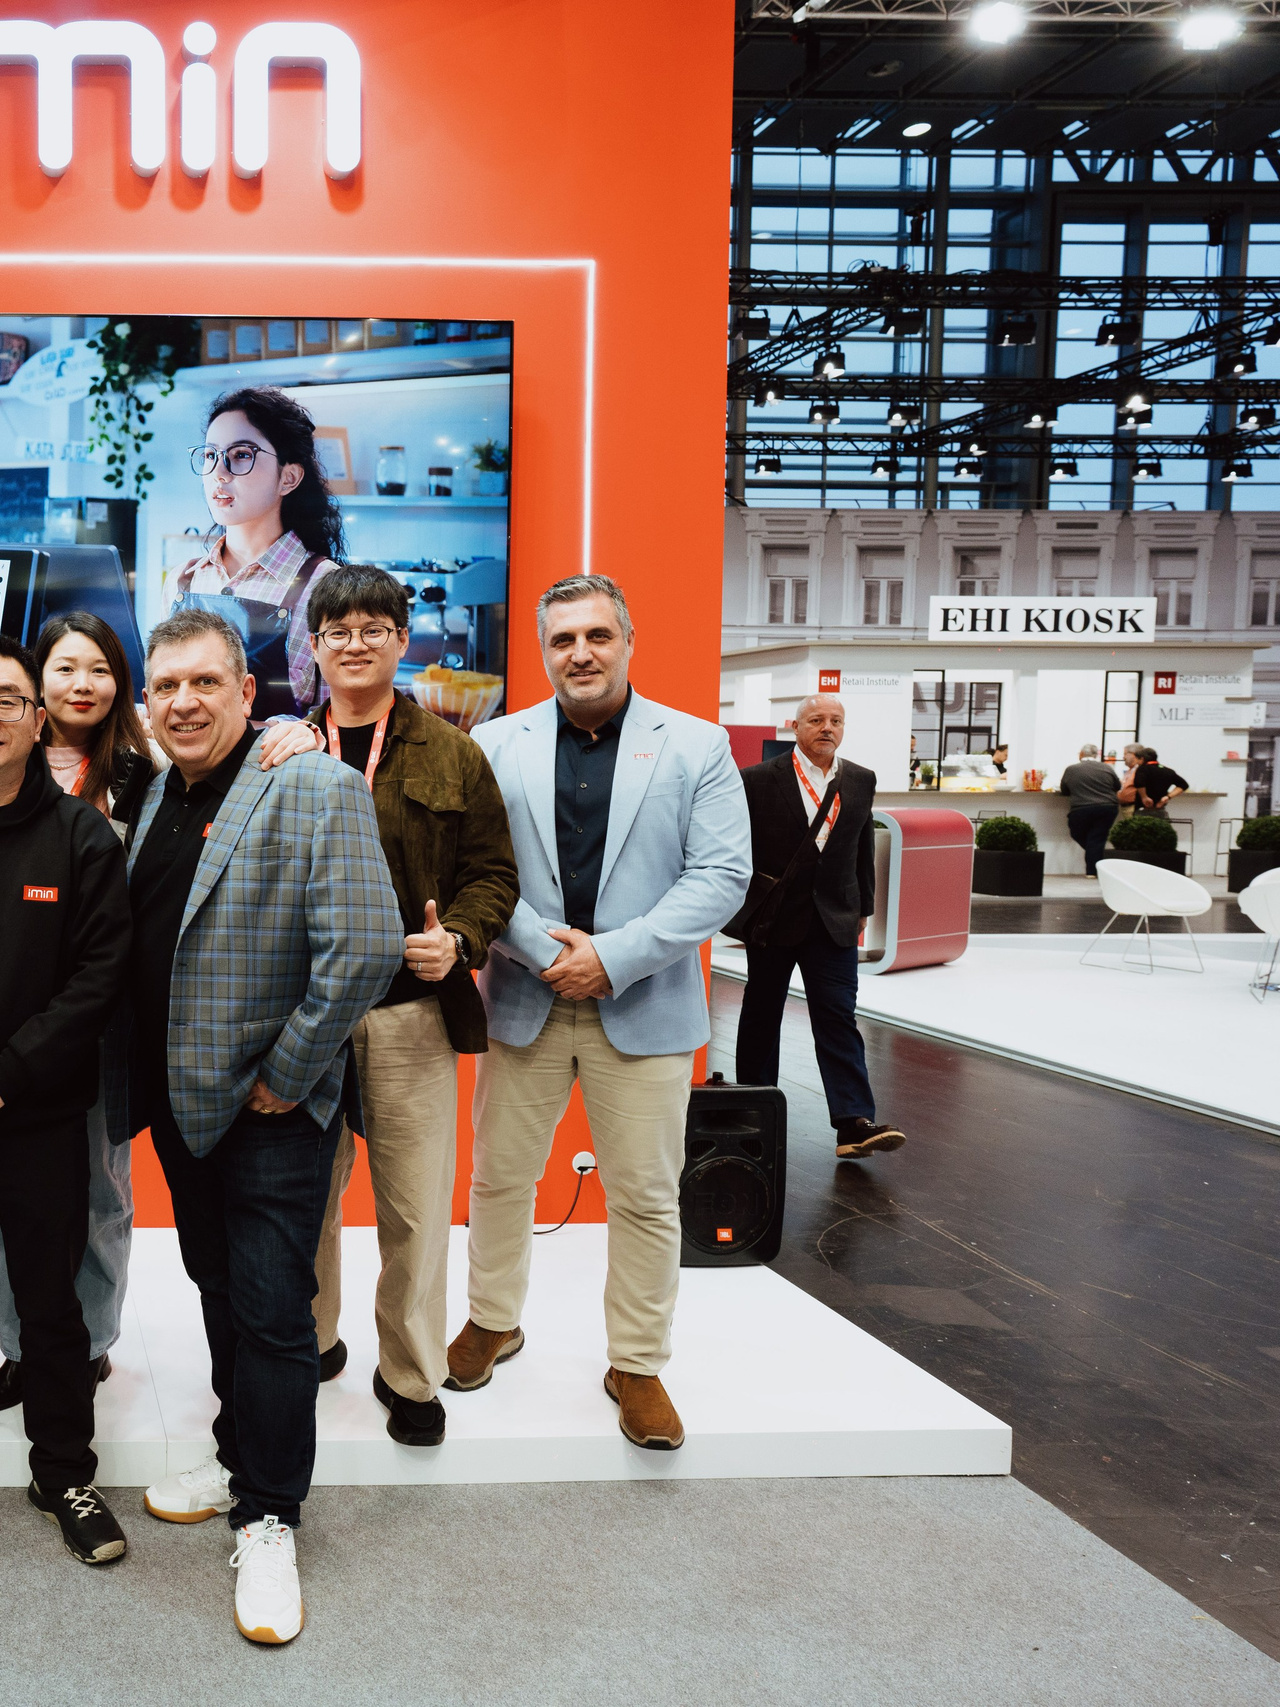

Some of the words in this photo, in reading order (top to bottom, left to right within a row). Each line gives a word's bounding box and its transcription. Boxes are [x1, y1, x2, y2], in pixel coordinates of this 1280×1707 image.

[940, 608, 1011, 632] EHI
[1022, 608, 1144, 633] KIOSK
[821, 676, 838, 686] EHI
[842, 677, 865, 686] Retail
[866, 677, 900, 686] Institute
[1157, 678, 1173, 689] RI
[1159, 708, 1195, 720] MLF
